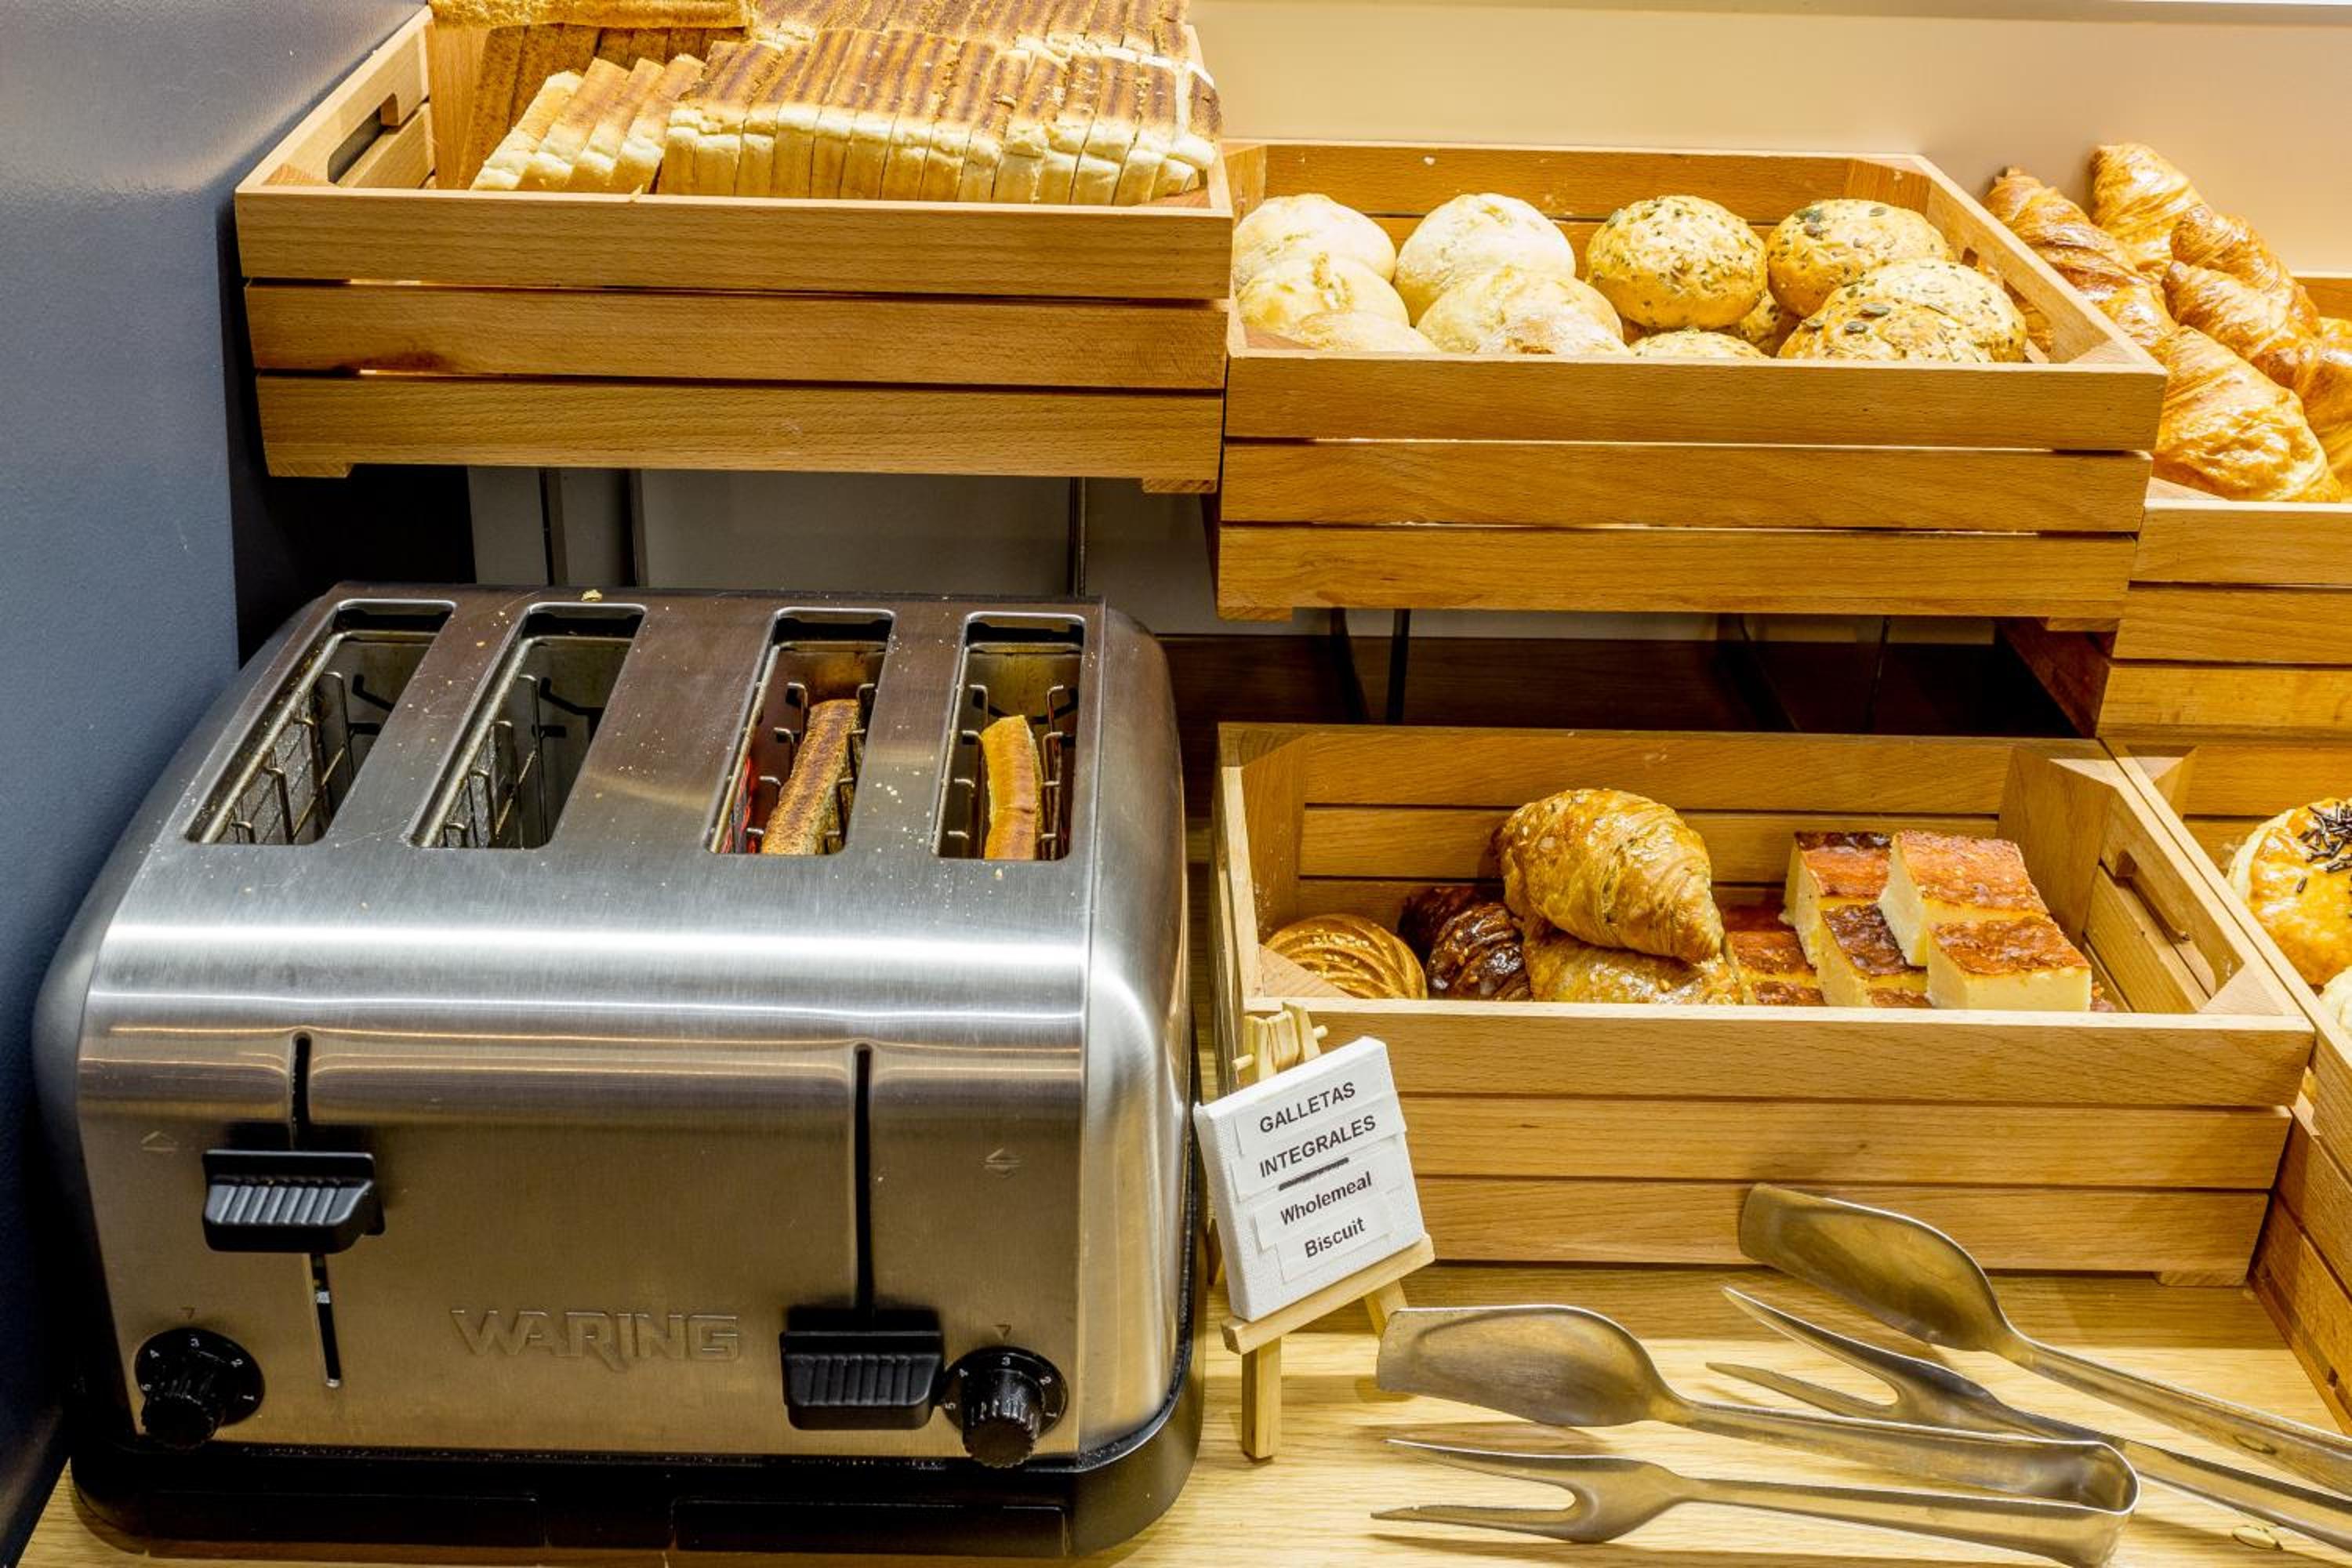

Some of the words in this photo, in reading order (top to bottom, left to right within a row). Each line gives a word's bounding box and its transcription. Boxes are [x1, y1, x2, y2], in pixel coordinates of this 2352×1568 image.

[1259, 1082, 1356, 1133] GALLETAS
[1259, 1116, 1377, 1178] INTEGRALES
[1279, 1171, 1372, 1225] Wholemeal
[1304, 1217, 1366, 1258] Biscuit
[150, 1348, 161, 1359] 4
[190, 1338, 201, 1348] 3
[230, 1358, 244, 1368] 2
[450, 1309, 739, 1374] WARING
[958, 1367, 969, 1378] 4
[1000, 1356, 1011, 1367] 3
[1039, 1375, 1052, 1386] 2
